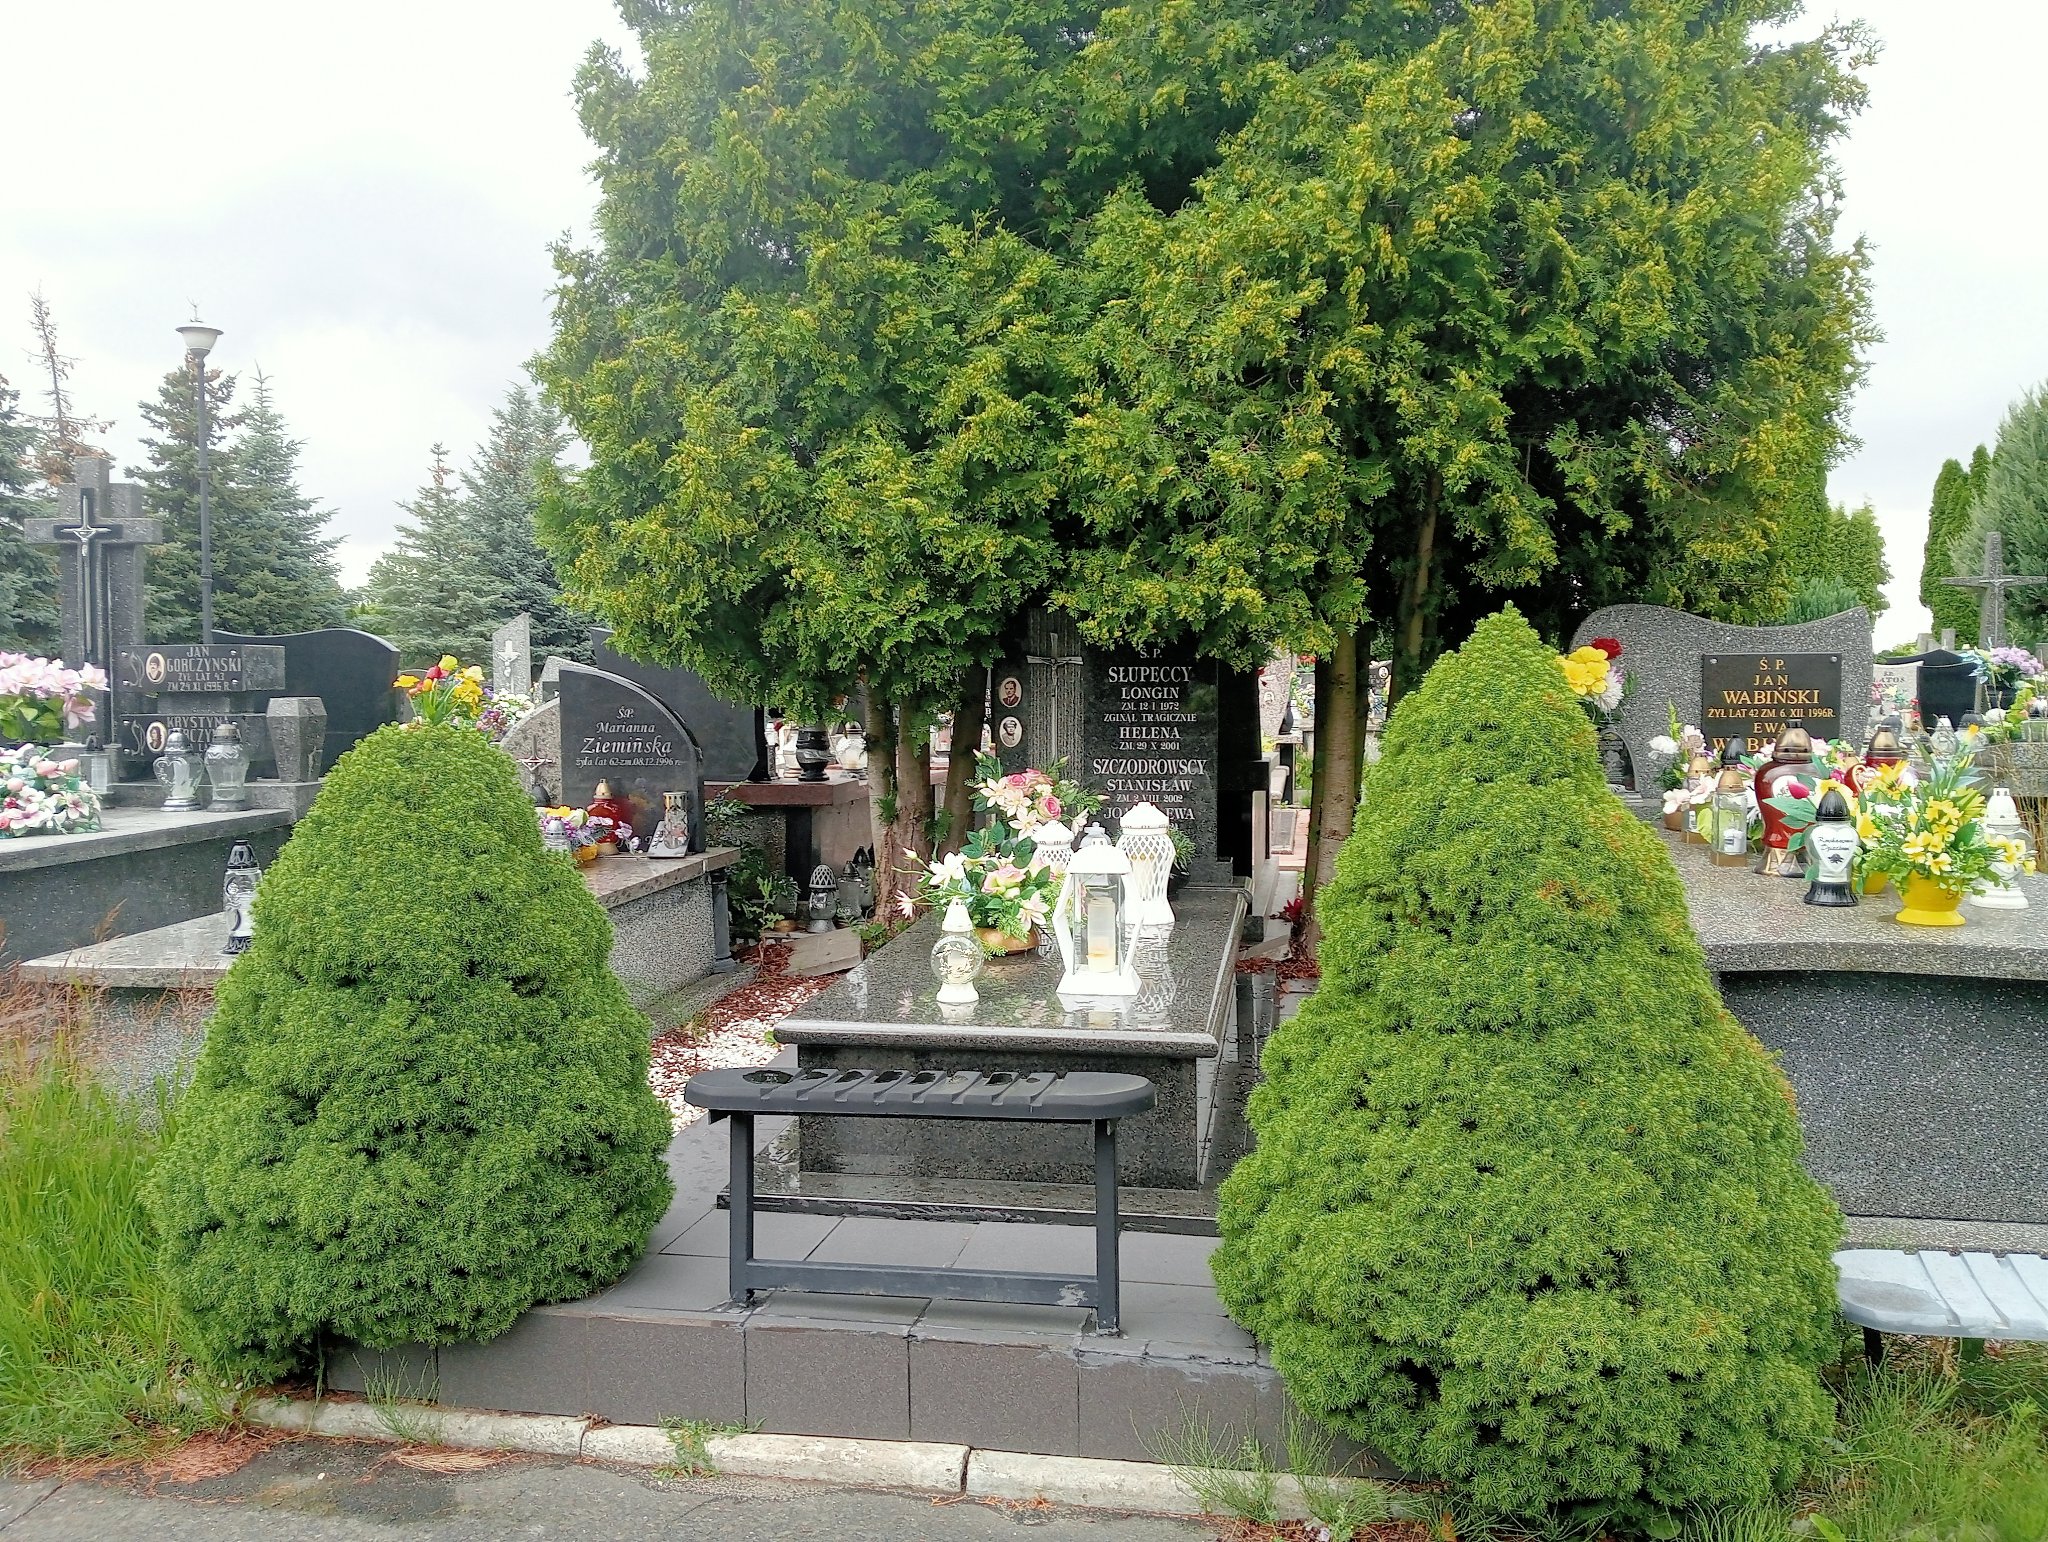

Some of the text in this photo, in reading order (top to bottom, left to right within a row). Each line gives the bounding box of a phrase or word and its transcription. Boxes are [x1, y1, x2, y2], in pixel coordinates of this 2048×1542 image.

[186, 646, 210, 658] JAN
[195, 672, 211, 681] LAT
[214, 672, 225, 681] 43
[1108, 666, 1192, 682] SŁUPECCY
[1753, 674, 1789, 686] JAN
[1121, 686, 1179, 700] LONGIN
[1722, 686, 1820, 704] WABIŃSKI
[1139, 702, 1149, 711] 12
[1160, 702, 1180, 711] 1972
[1141, 713, 1198, 722] TRAGICZNIE
[1729, 708, 1748, 718] LAT
[1748, 708, 1759, 718] 42
[596, 721, 656, 733] Marianna
[1119, 726, 1182, 739] HELENA
[1136, 741, 1147, 750] 29
[1150, 742, 1157, 750] X
[1160, 741, 1180, 750] 2001
[594, 756, 607, 766] lat
[1092, 758, 1208, 775] SZCZODROWSCY
[1107, 778, 1192, 792] STANISŁAW
[1133, 793, 1139, 802] 2
[1163, 794, 1184, 803] 2002
